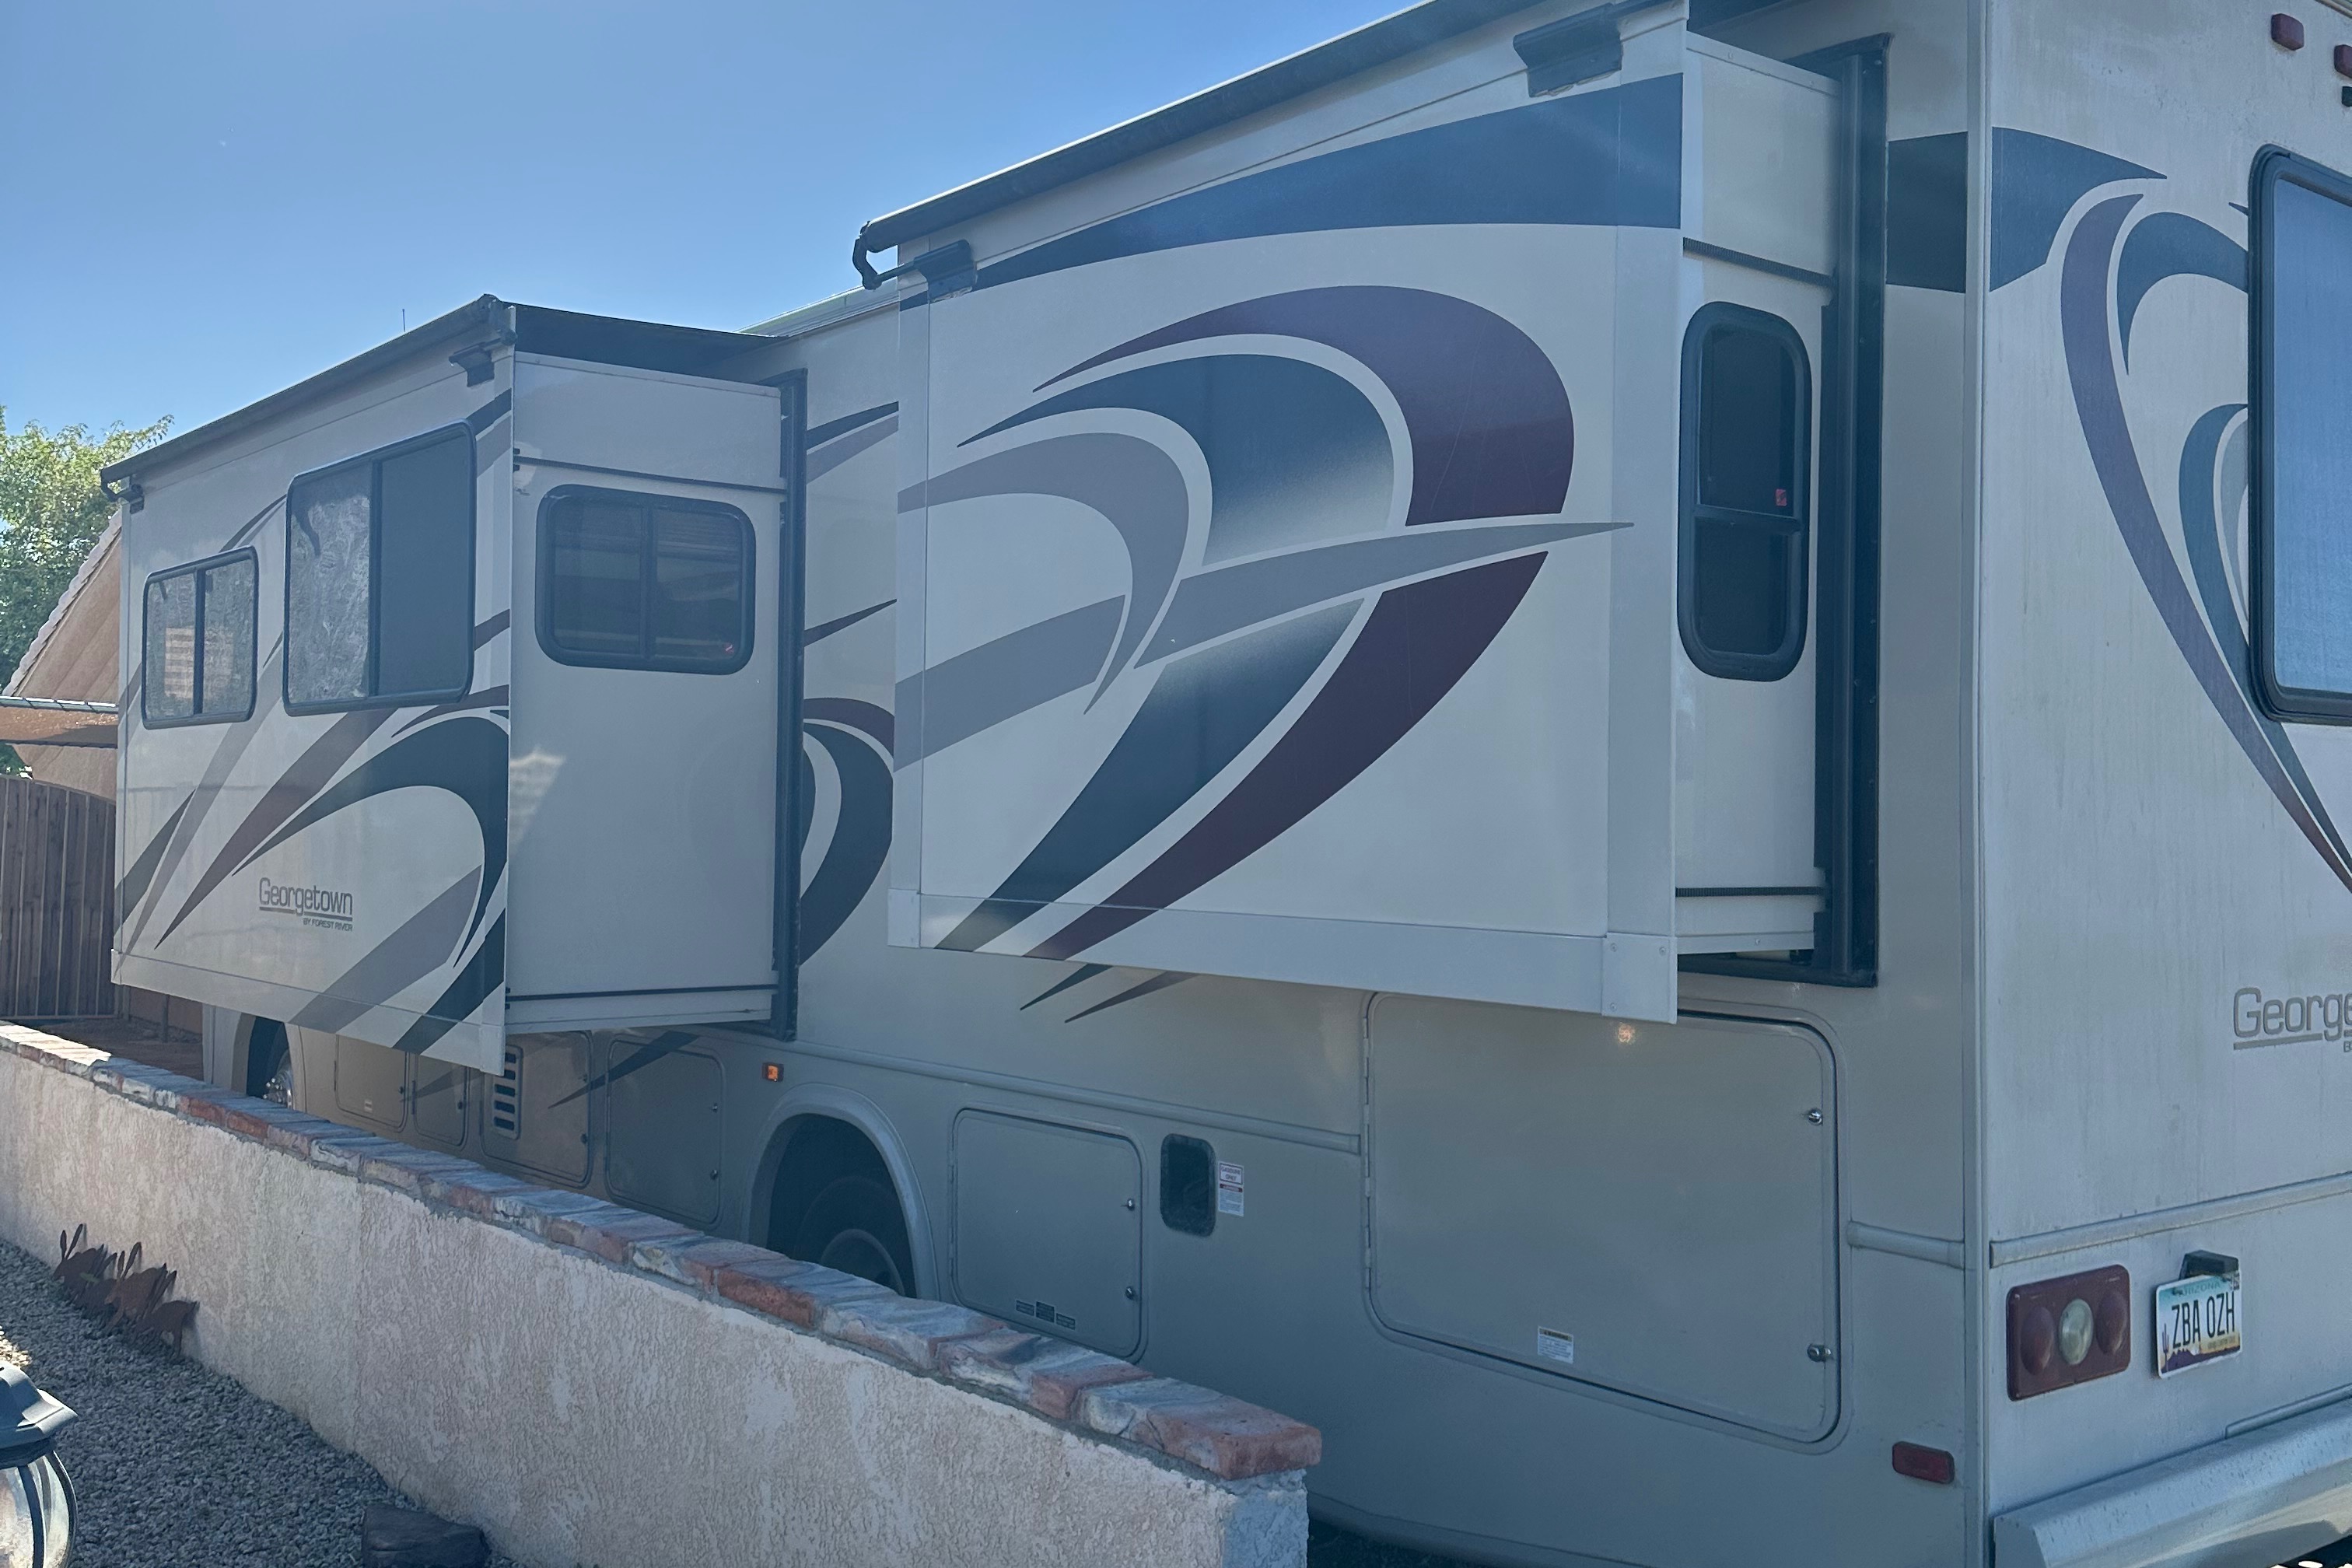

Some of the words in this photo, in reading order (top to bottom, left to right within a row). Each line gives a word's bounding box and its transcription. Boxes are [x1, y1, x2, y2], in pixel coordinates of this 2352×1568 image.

[259, 877, 353, 916] Georgetown
[312, 919, 334, 929] FOREST
[335, 922, 353, 932] RIVER
[2171, 1300, 2201, 1349] ZBA
